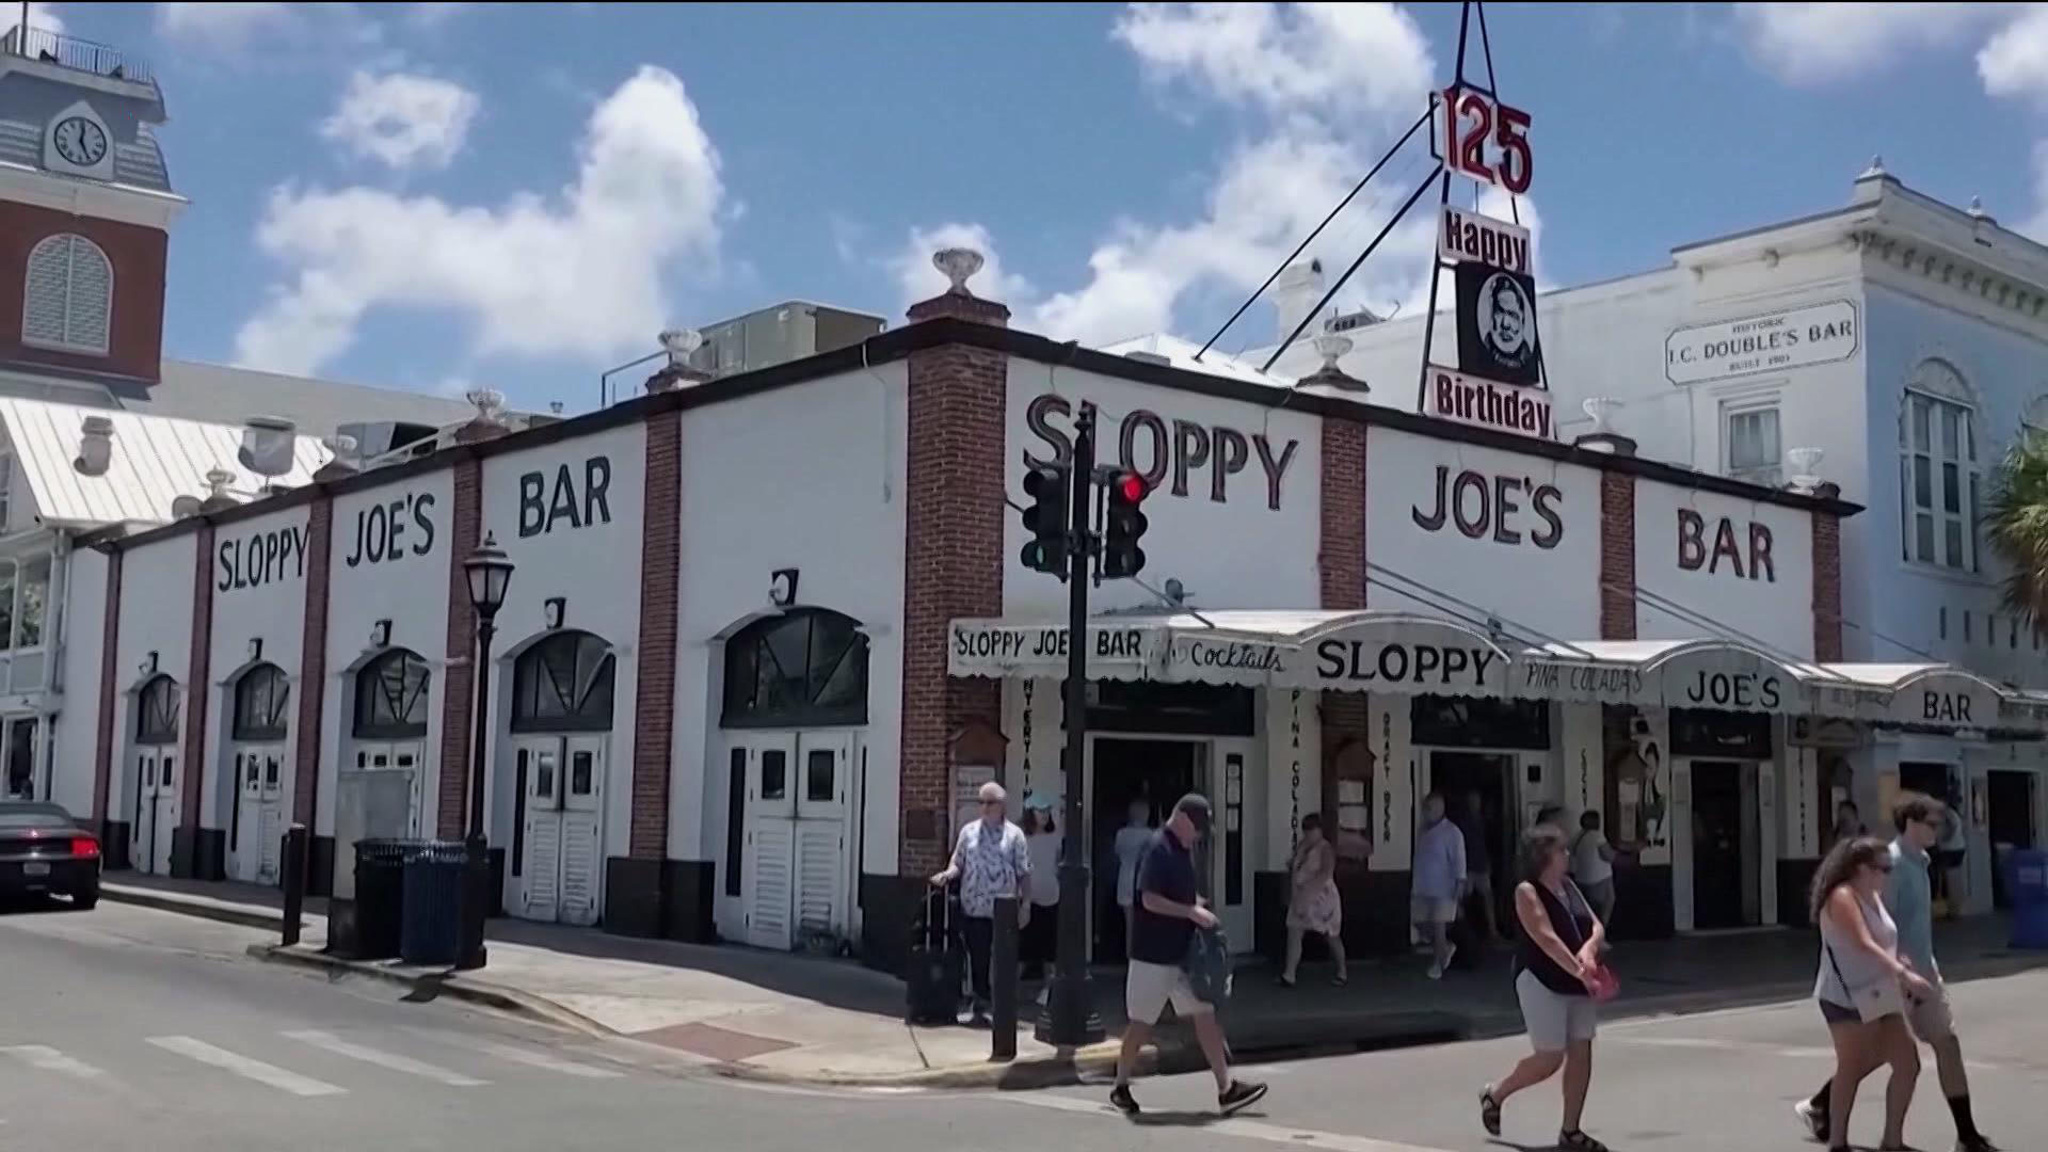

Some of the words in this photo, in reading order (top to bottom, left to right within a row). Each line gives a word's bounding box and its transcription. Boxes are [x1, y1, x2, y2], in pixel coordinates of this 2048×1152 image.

[1443, 86, 1532, 194] 125
[1444, 209, 1527, 273] Happy
[1704, 329, 1799, 360] DOUBLE'S
[1808, 320, 1853, 343] BAR
[1436, 372, 1551, 439] Birthday
[218, 522, 310, 593] SLOPPY
[346, 492, 436, 568] JOE'S
[518, 456, 612, 539] BAR
[1412, 465, 1563, 550] JOE'S
[1677, 507, 1776, 583] BAR
[957, 630, 1025, 657] SLOPPY
[1097, 629, 1141, 657] BAR
[1191, 641, 1287, 672] Cocktails
[1317, 639, 1495, 686] SLOPPY
[1570, 665, 1643, 692] COLADAS
[1687, 670, 1781, 709] JOE'S
[1922, 690, 1972, 722] BAR
